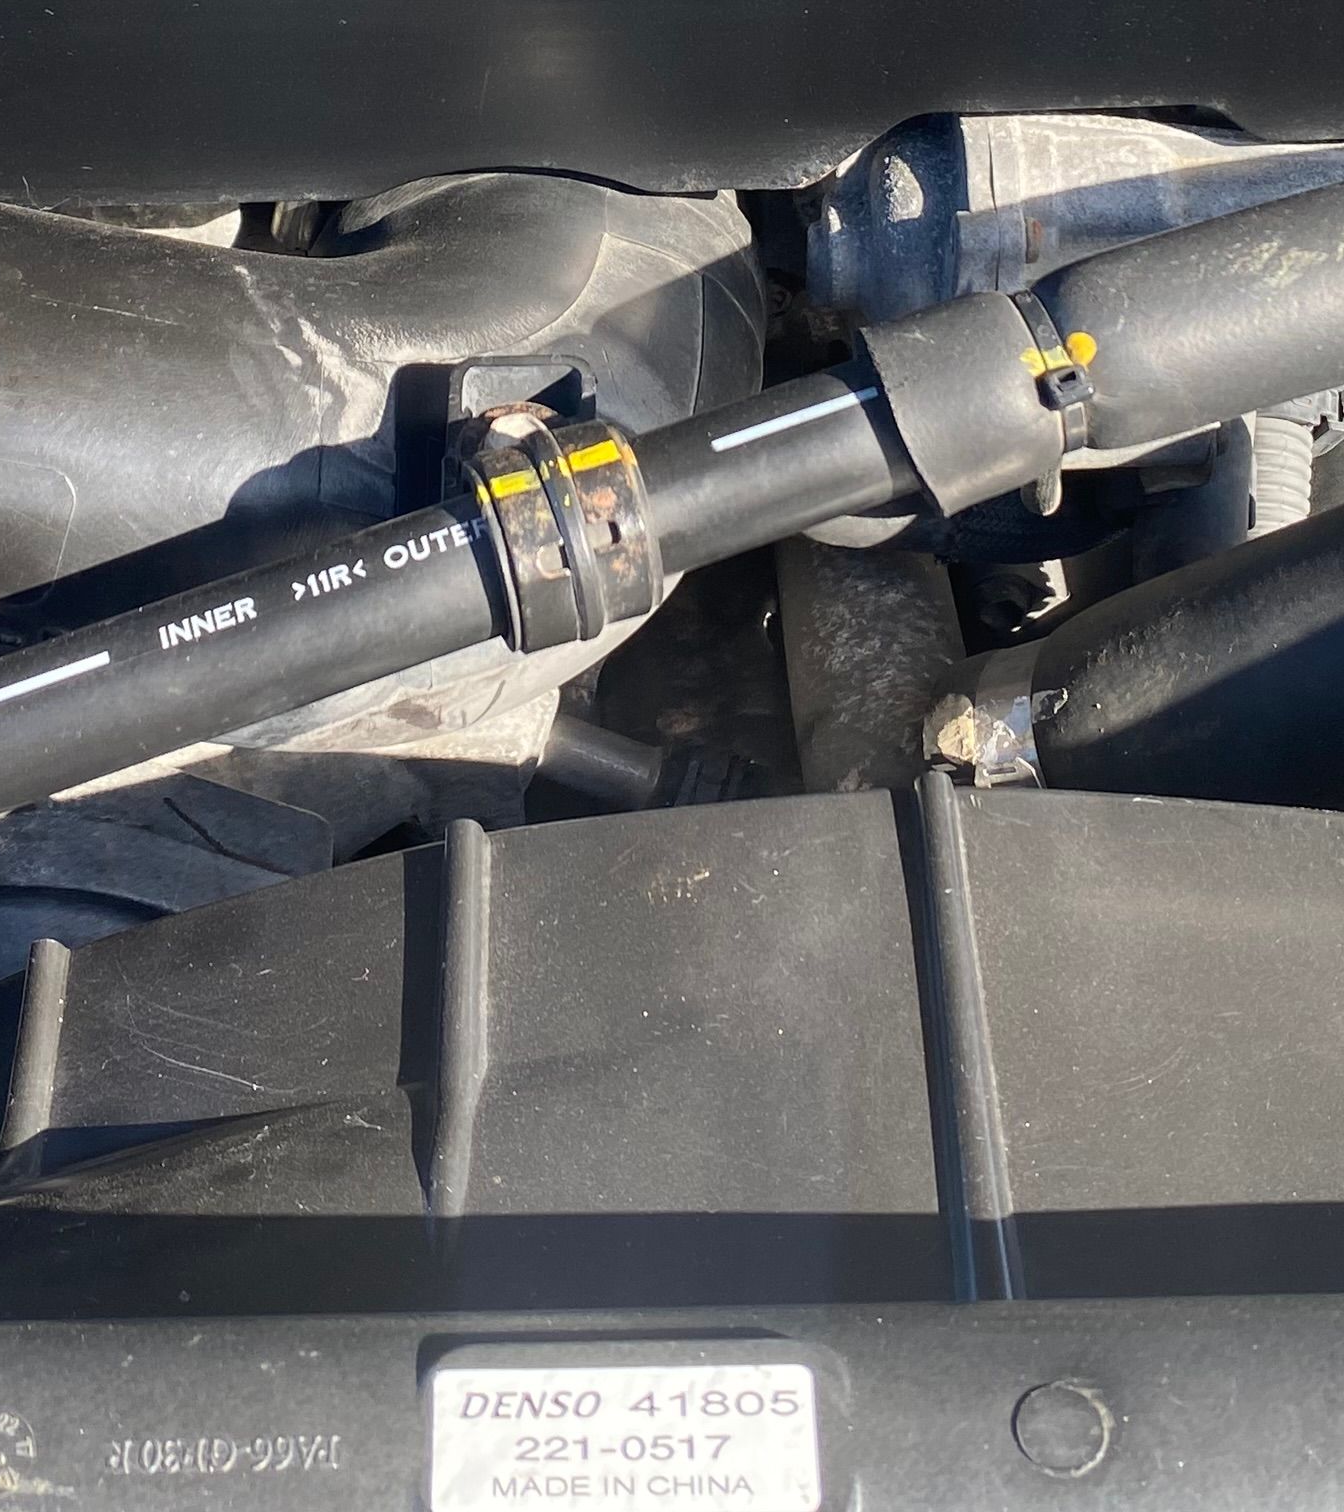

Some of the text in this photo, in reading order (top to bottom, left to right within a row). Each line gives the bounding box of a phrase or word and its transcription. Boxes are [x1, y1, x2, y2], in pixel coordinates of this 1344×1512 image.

[157, 596, 258, 650] INNER
[459, 1389, 800, 1420] DENSO 41805
[514, 1434, 732, 1462] 221-0517
[492, 1475, 754, 1498] MADE IN CHINA
